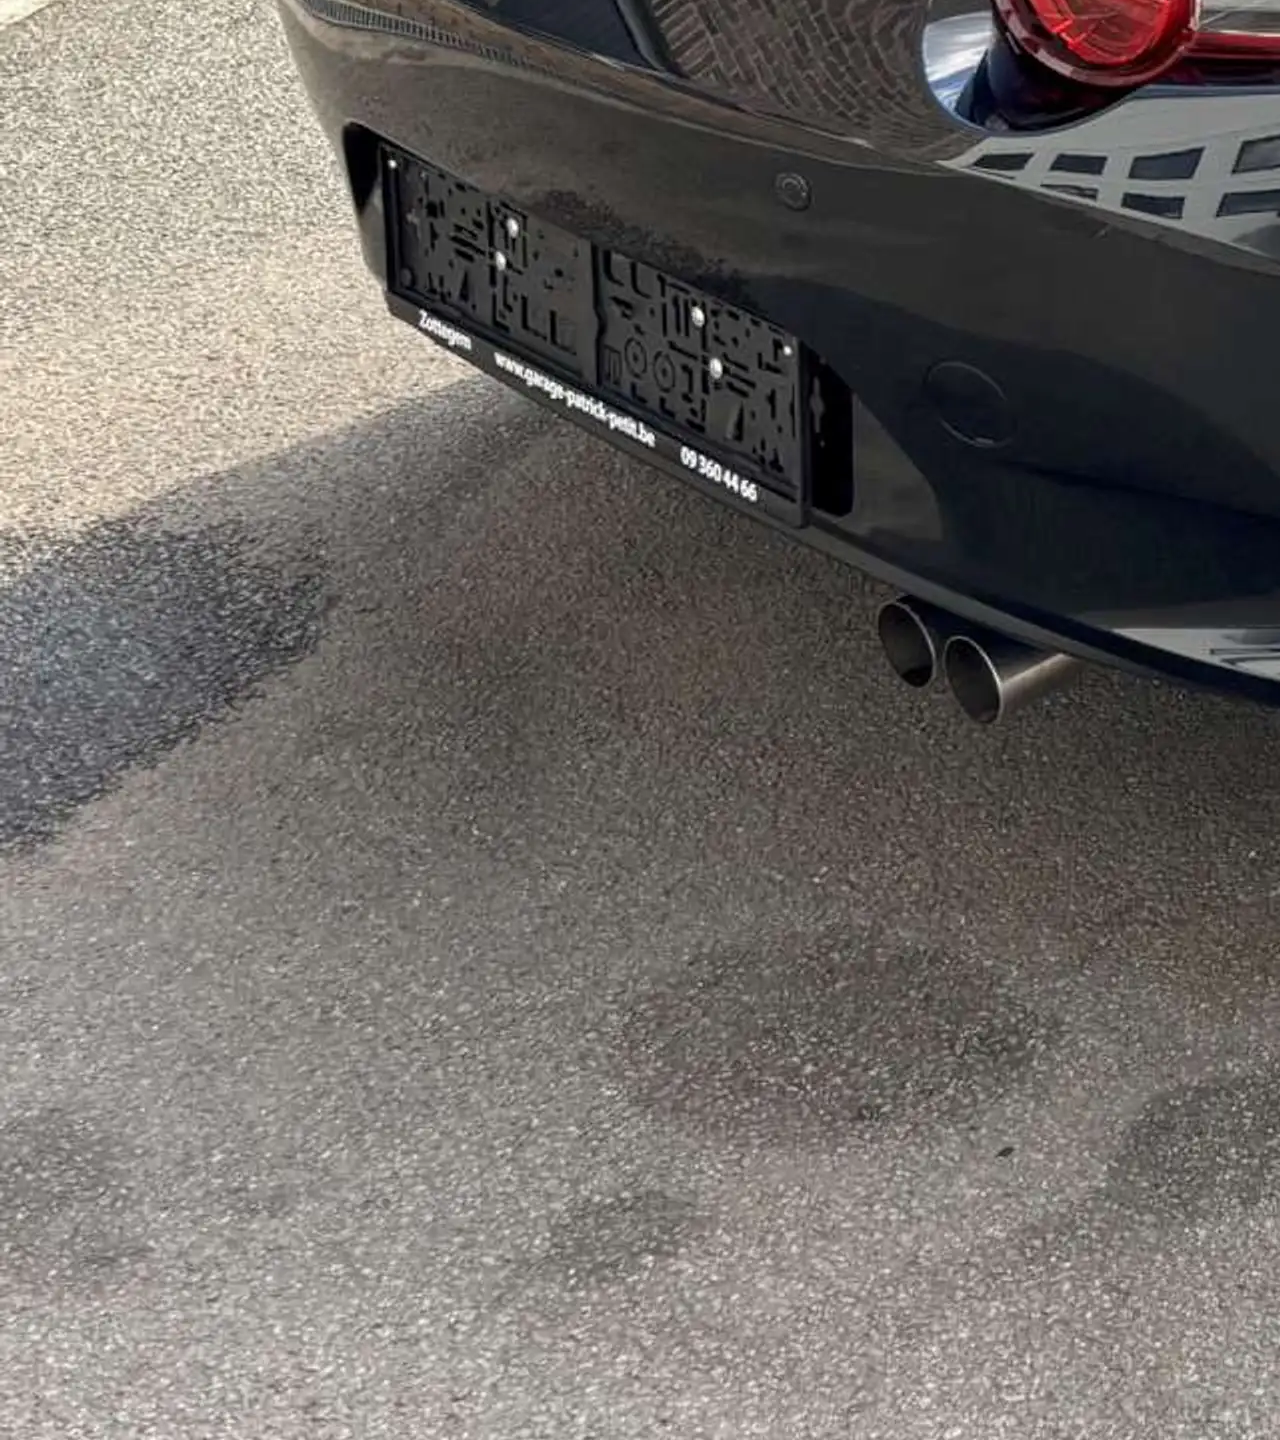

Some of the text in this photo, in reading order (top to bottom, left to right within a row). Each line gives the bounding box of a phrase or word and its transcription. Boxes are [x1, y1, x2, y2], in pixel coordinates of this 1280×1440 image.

[681, 446, 697, 469] 09
[699, 455, 722, 482] 360
[724, 470, 739, 493] 44
[741, 480, 757, 502] 66
